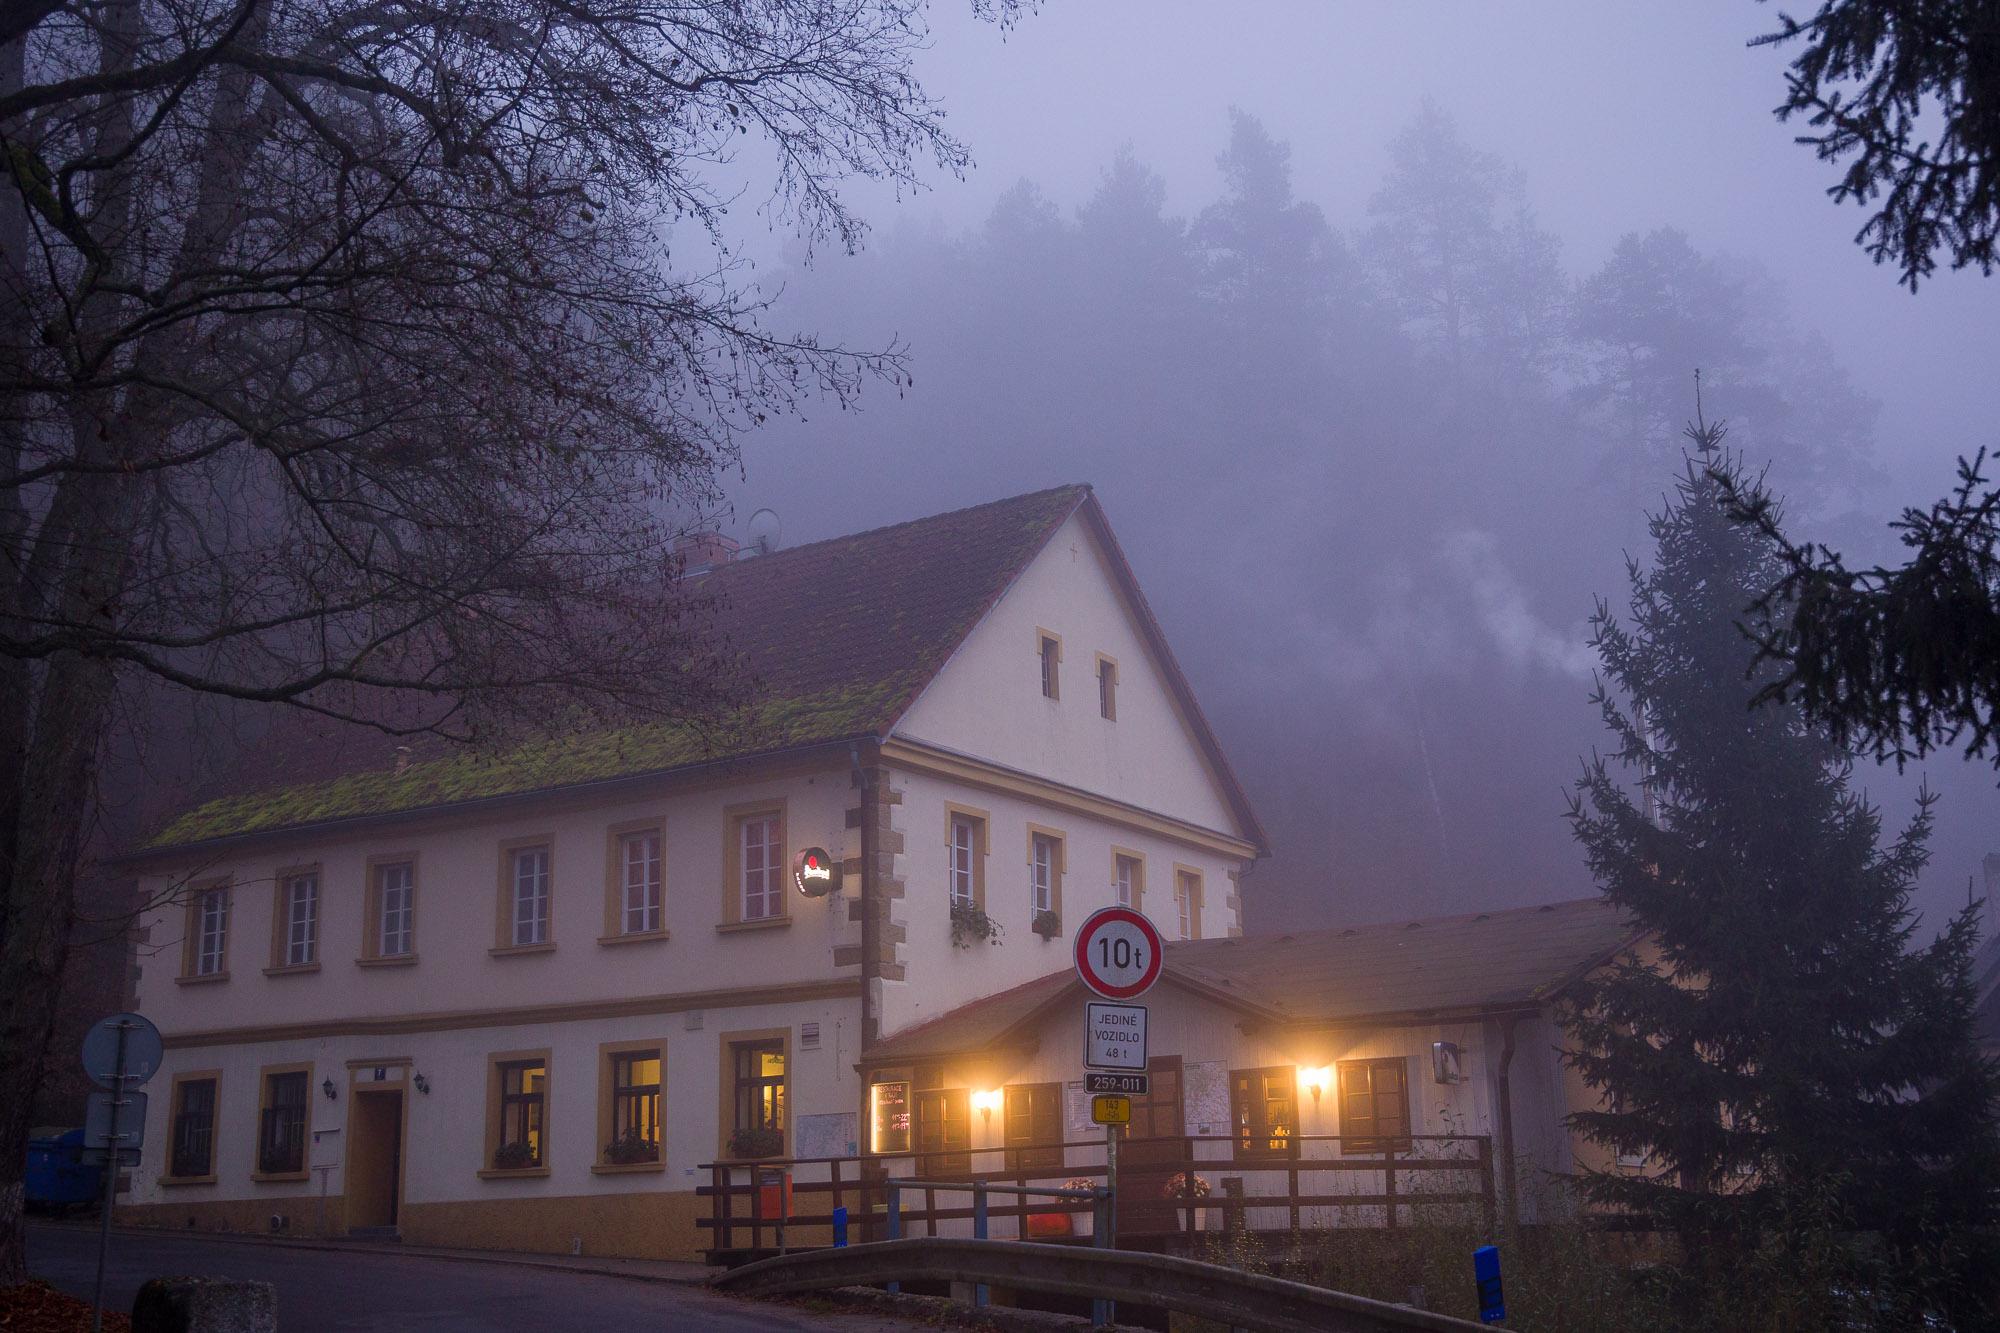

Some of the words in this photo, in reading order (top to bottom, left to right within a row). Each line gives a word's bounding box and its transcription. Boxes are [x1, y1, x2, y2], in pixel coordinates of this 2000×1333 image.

[1098, 1013, 1137, 1026] JEDINÉ
[1094, 1029, 1140, 1043] VOZIDLO
[1105, 1048, 1119, 1058] 48
[1094, 1076, 1141, 1091] 259-011
